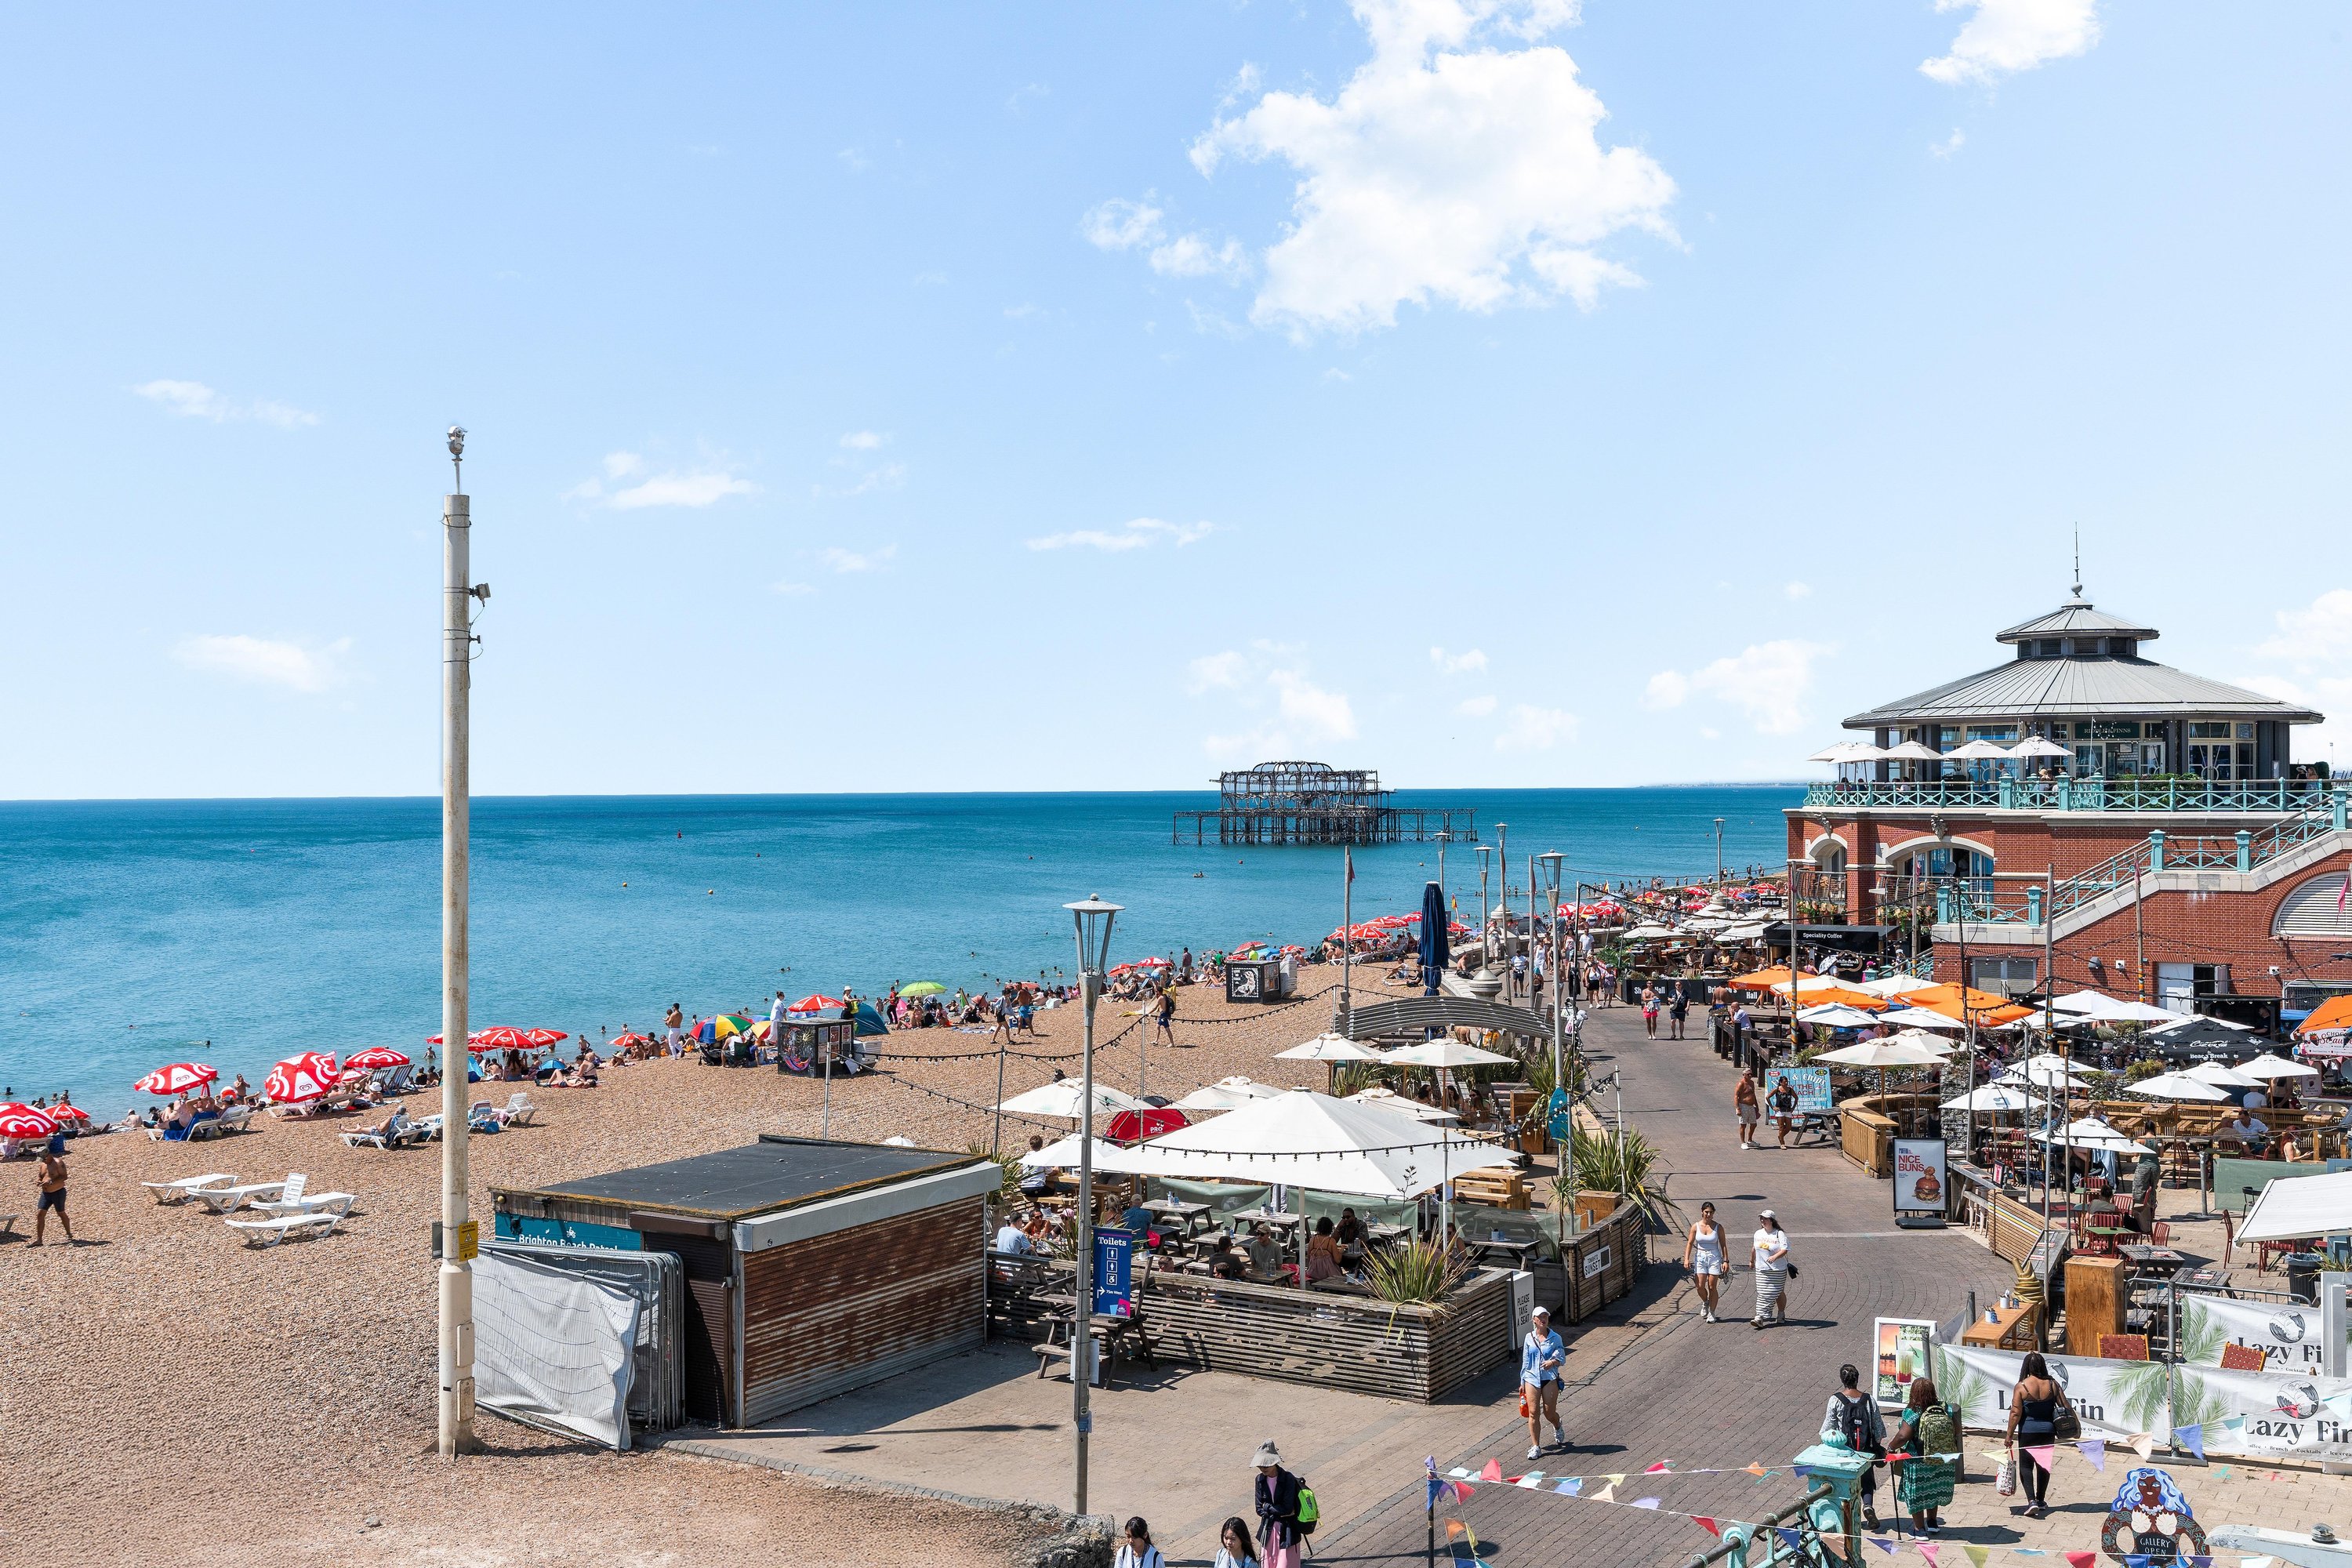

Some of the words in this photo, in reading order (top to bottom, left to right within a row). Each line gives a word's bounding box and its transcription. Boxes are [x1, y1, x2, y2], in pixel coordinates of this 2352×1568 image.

[1746, 991, 1758, 1000] Hall
[1898, 1155, 1921, 1163] NICE
[518, 1233, 558, 1247] Brighton
[560, 1238, 587, 1250] Beach
[1098, 1236, 1127, 1247] Toilets
[1584, 1259, 1600, 1276] SUNSET
[1517, 1294, 1530, 1307] PLEASE
[1518, 1304, 1528, 1316] TAKE
[1520, 1314, 1530, 1326] SEAT
[2303, 1345, 2321, 1363] Fi
[2241, 1413, 2305, 1445] Lazy
[2140, 1537, 2171, 1548] GALLERY
[2144, 1547, 2166, 1555] OPEN
